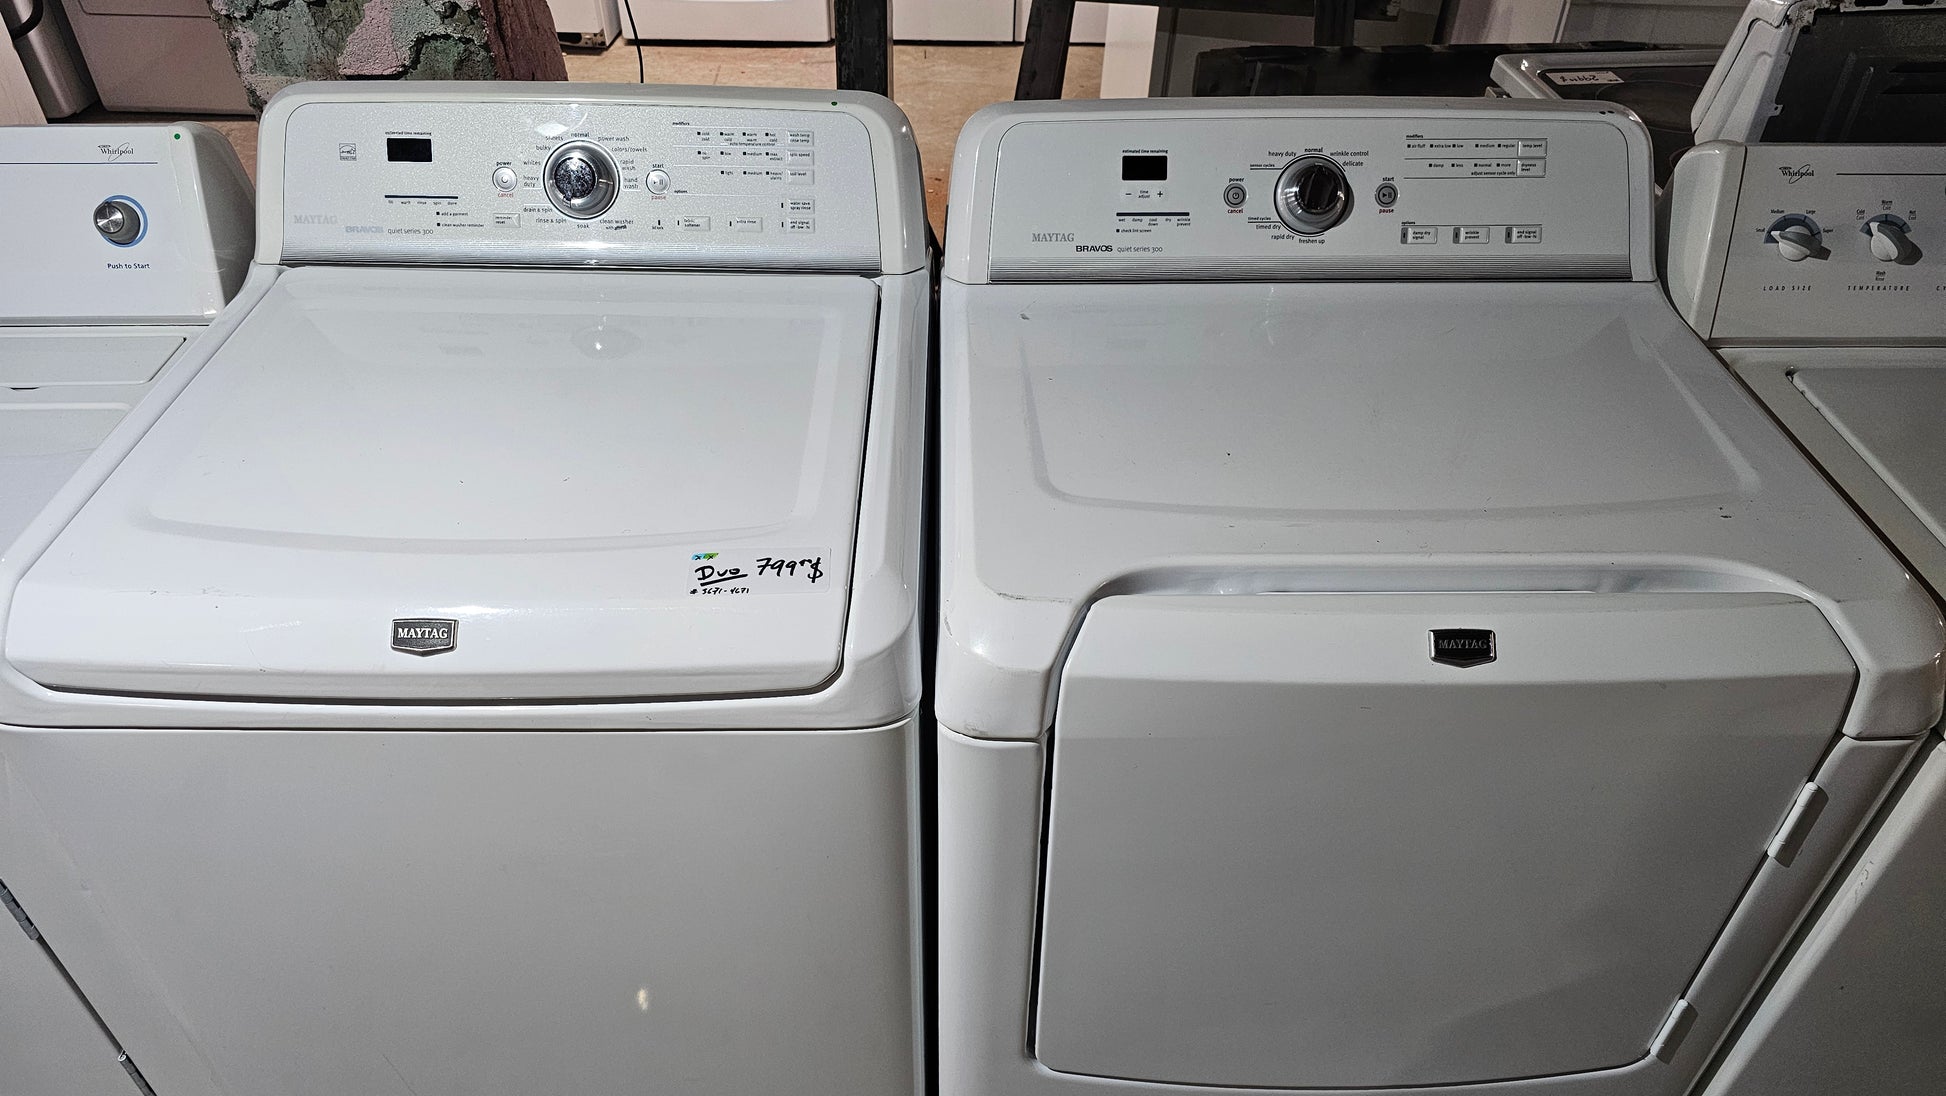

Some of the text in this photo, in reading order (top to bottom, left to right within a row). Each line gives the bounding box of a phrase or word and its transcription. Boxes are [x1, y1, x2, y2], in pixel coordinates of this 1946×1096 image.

[100, 147, 134, 157] Whirlpool
[1780, 168, 1815, 179] Whirlpool
[293, 214, 337, 225] MAYTAG
[345, 226, 384, 234] BRAVOS
[1031, 233, 1074, 243] MAYTAG
[1075, 245, 1113, 253] BRAVOS
[694, 565, 740, 580] Duo
[397, 627, 448, 639] MAYTAG
[1439, 639, 1488, 649] MAYTAG
